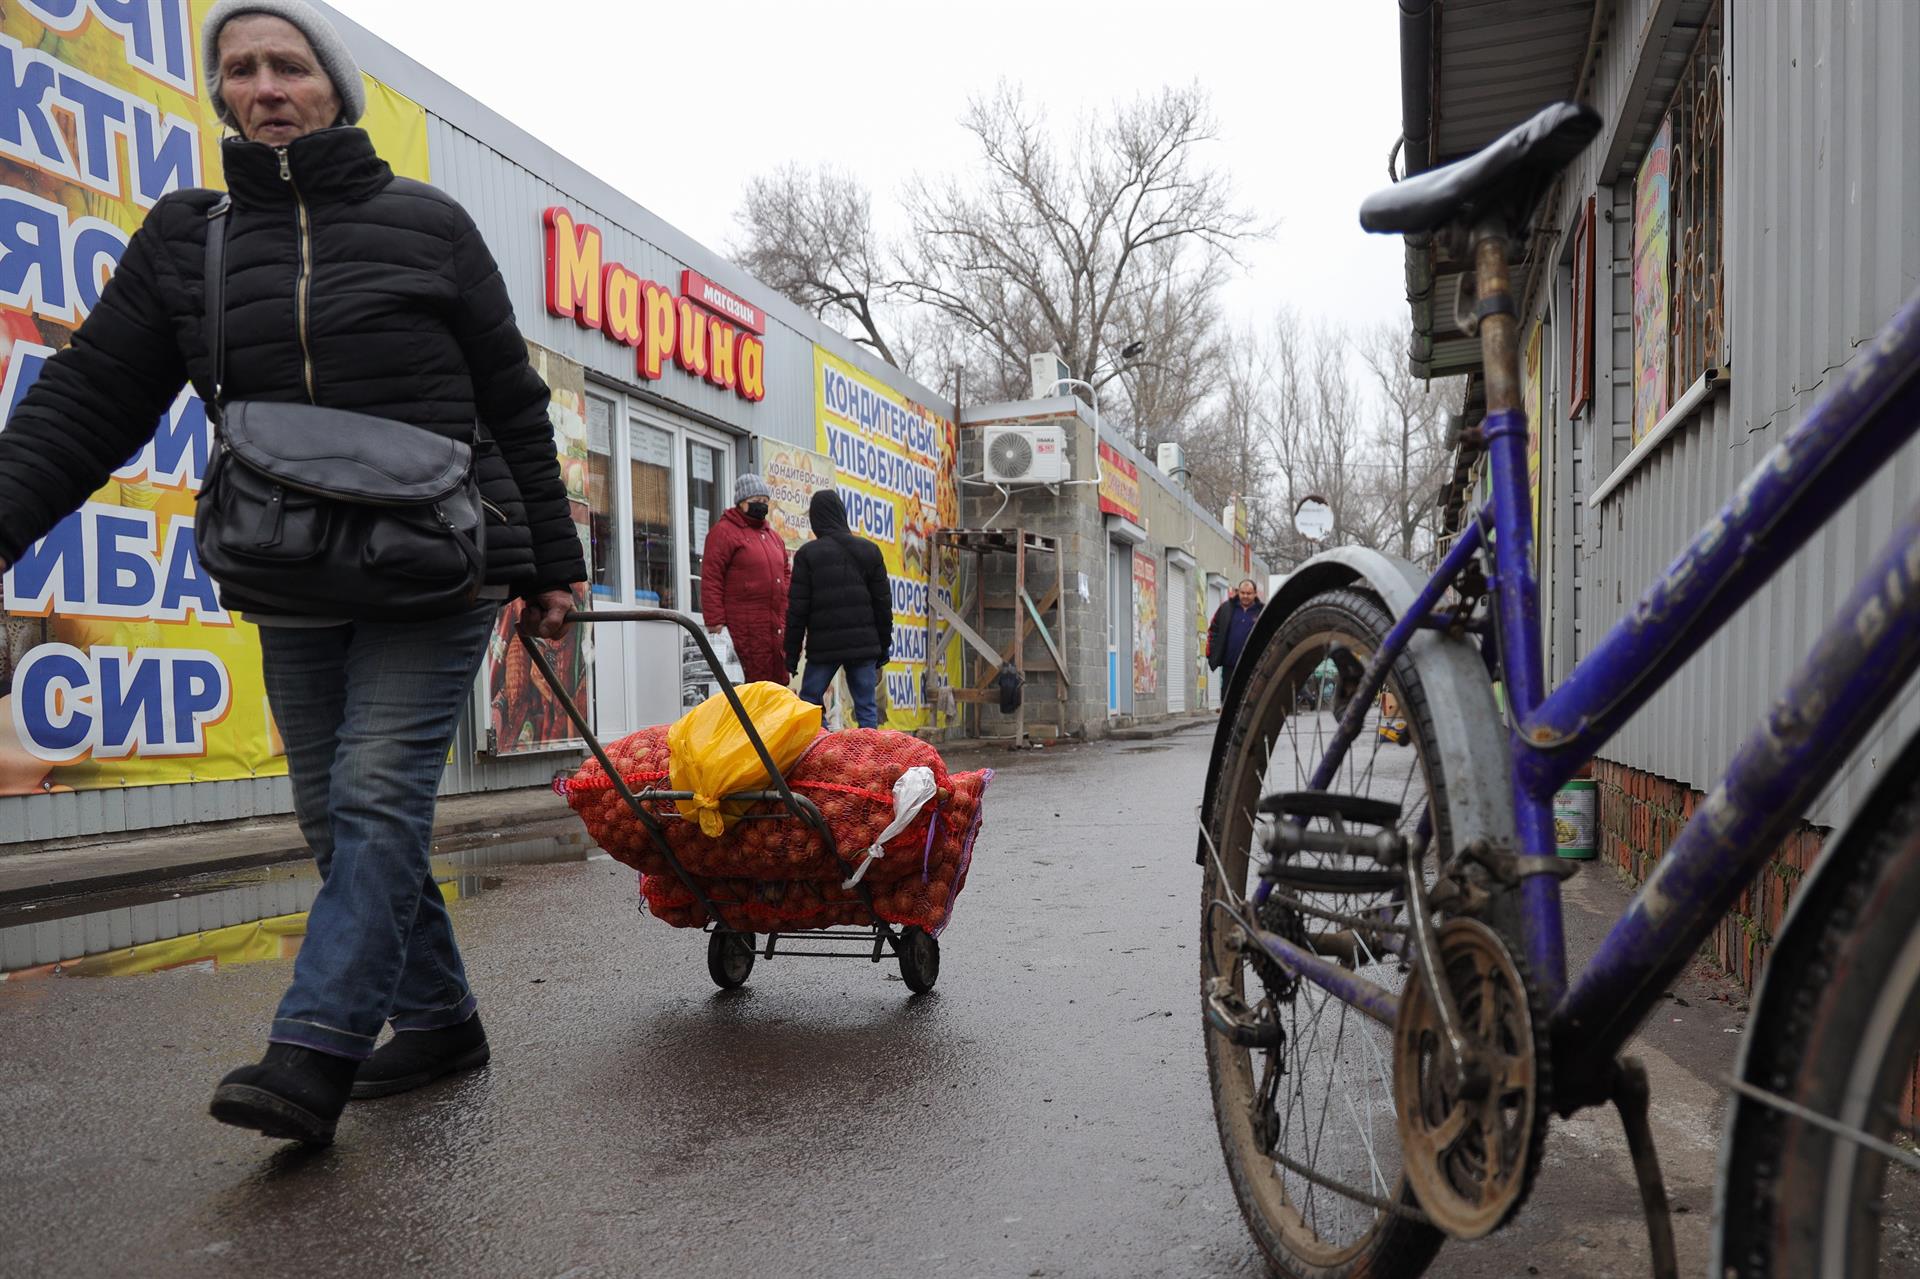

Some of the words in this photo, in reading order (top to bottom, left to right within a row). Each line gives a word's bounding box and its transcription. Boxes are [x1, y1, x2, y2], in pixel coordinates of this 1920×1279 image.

[544, 206, 765, 402] Марина
[824, 366, 941, 461] КОНДИТЕРСЬКІ,
[769, 461, 830, 489] кондитерские
[826, 425, 937, 504] ХЛІБОБУЛОЧНІ
[784, 514, 811, 529] издел
[835, 486, 895, 540] ИРОБИ
[21, 653, 223, 750] СИР
[887, 668, 917, 712] ЧАЙ,
